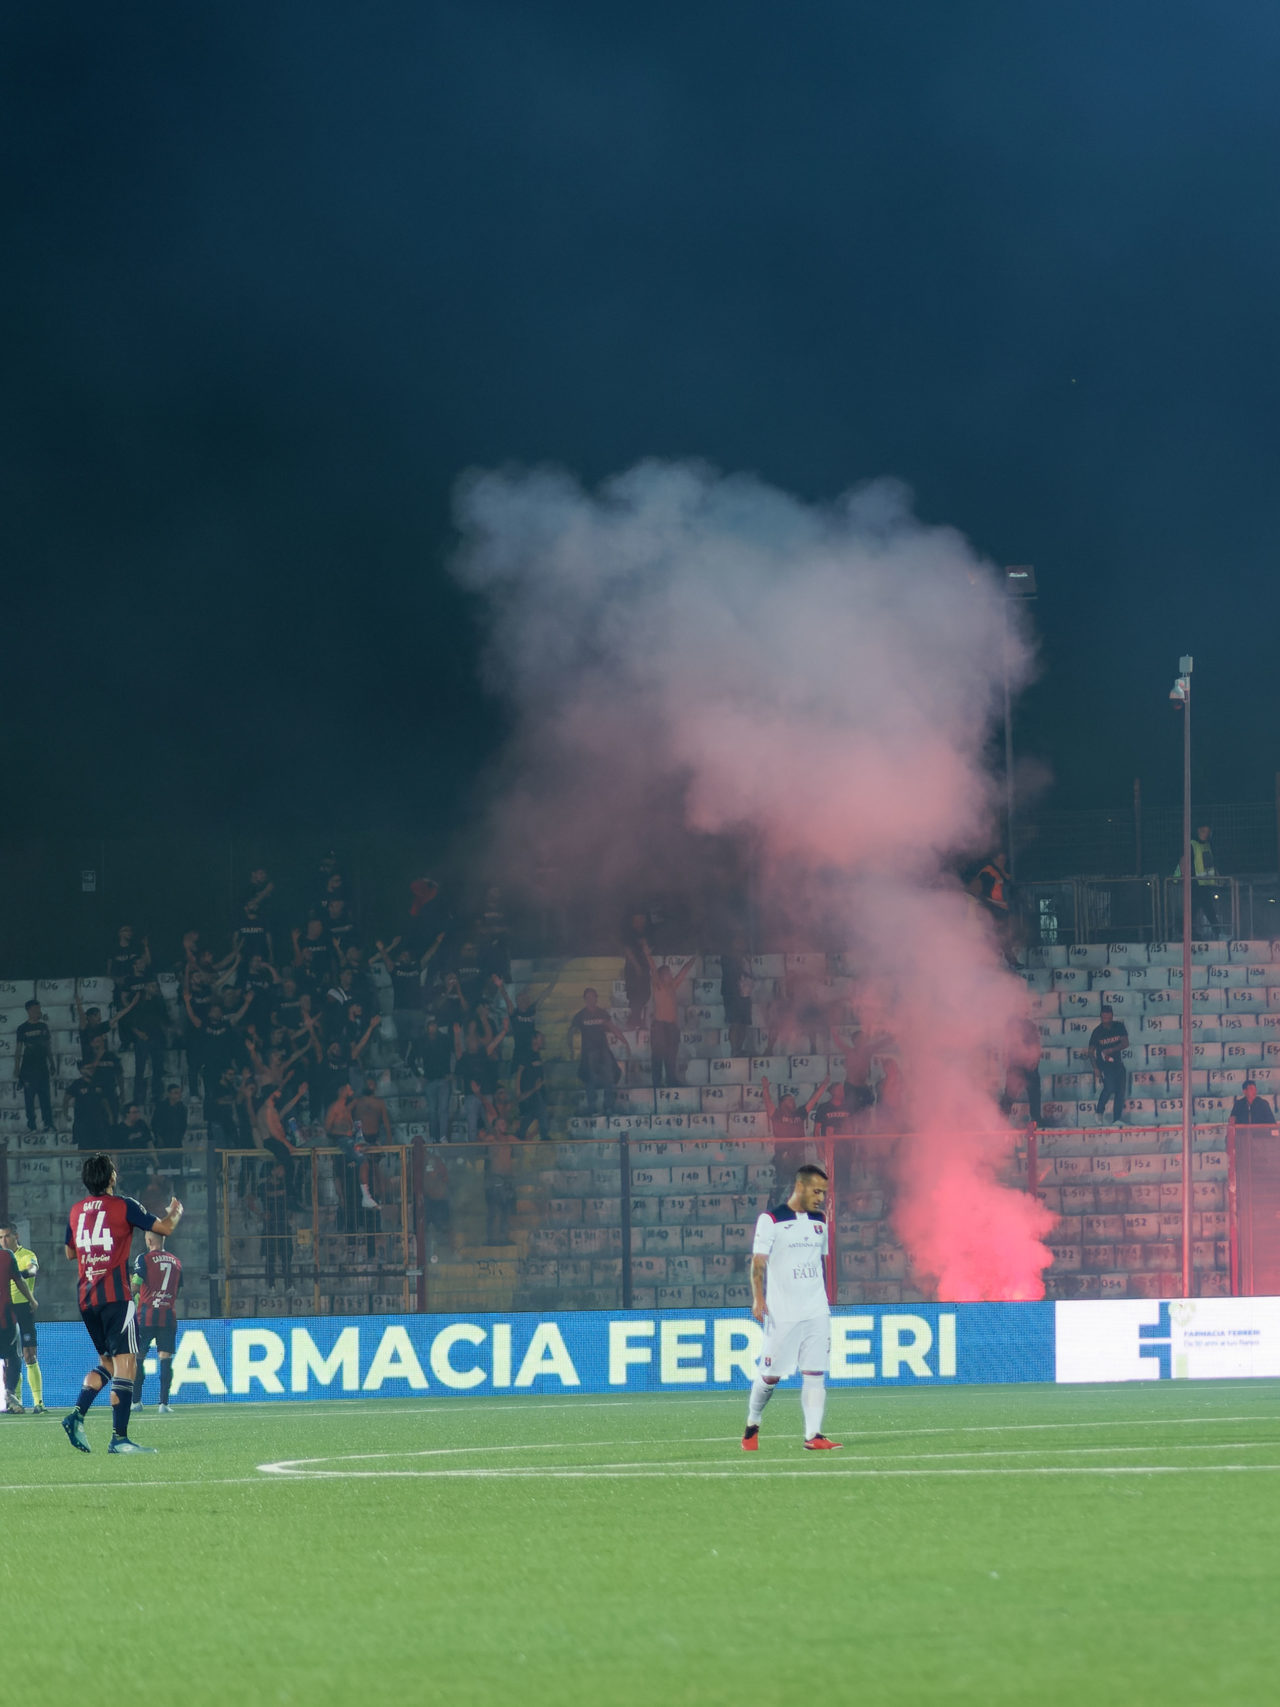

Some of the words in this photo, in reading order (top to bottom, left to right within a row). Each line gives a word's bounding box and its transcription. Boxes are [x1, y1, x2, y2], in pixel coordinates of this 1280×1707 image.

[83, 1200, 103, 1212] GATTI
[76, 1211, 113, 1252] 44
[159, 1263, 173, 1291] 7
[1183, 1329, 1226, 1337] FARMACIA
[607, 1314, 957, 1384] FERERI
